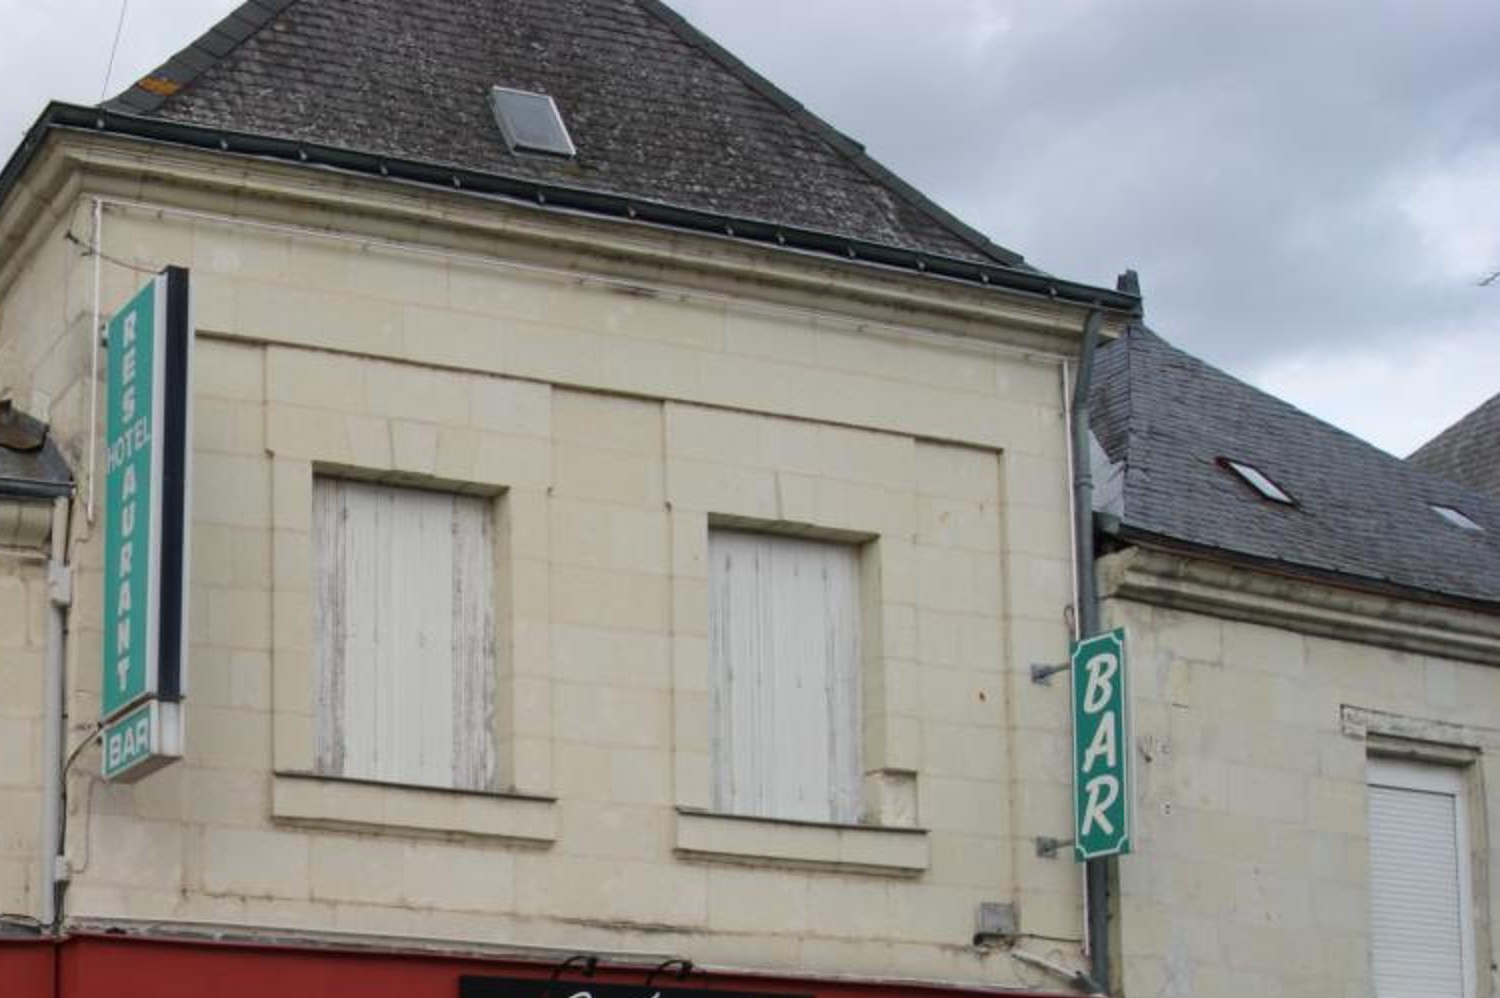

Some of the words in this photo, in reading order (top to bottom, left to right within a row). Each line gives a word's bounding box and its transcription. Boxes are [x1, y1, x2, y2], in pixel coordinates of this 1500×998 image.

[107, 415, 151, 473] HOTEL
[116, 309, 137, 692] RESTAURANT
[108, 720, 150, 768] BAR
[1081, 653, 1119, 836] BAR
